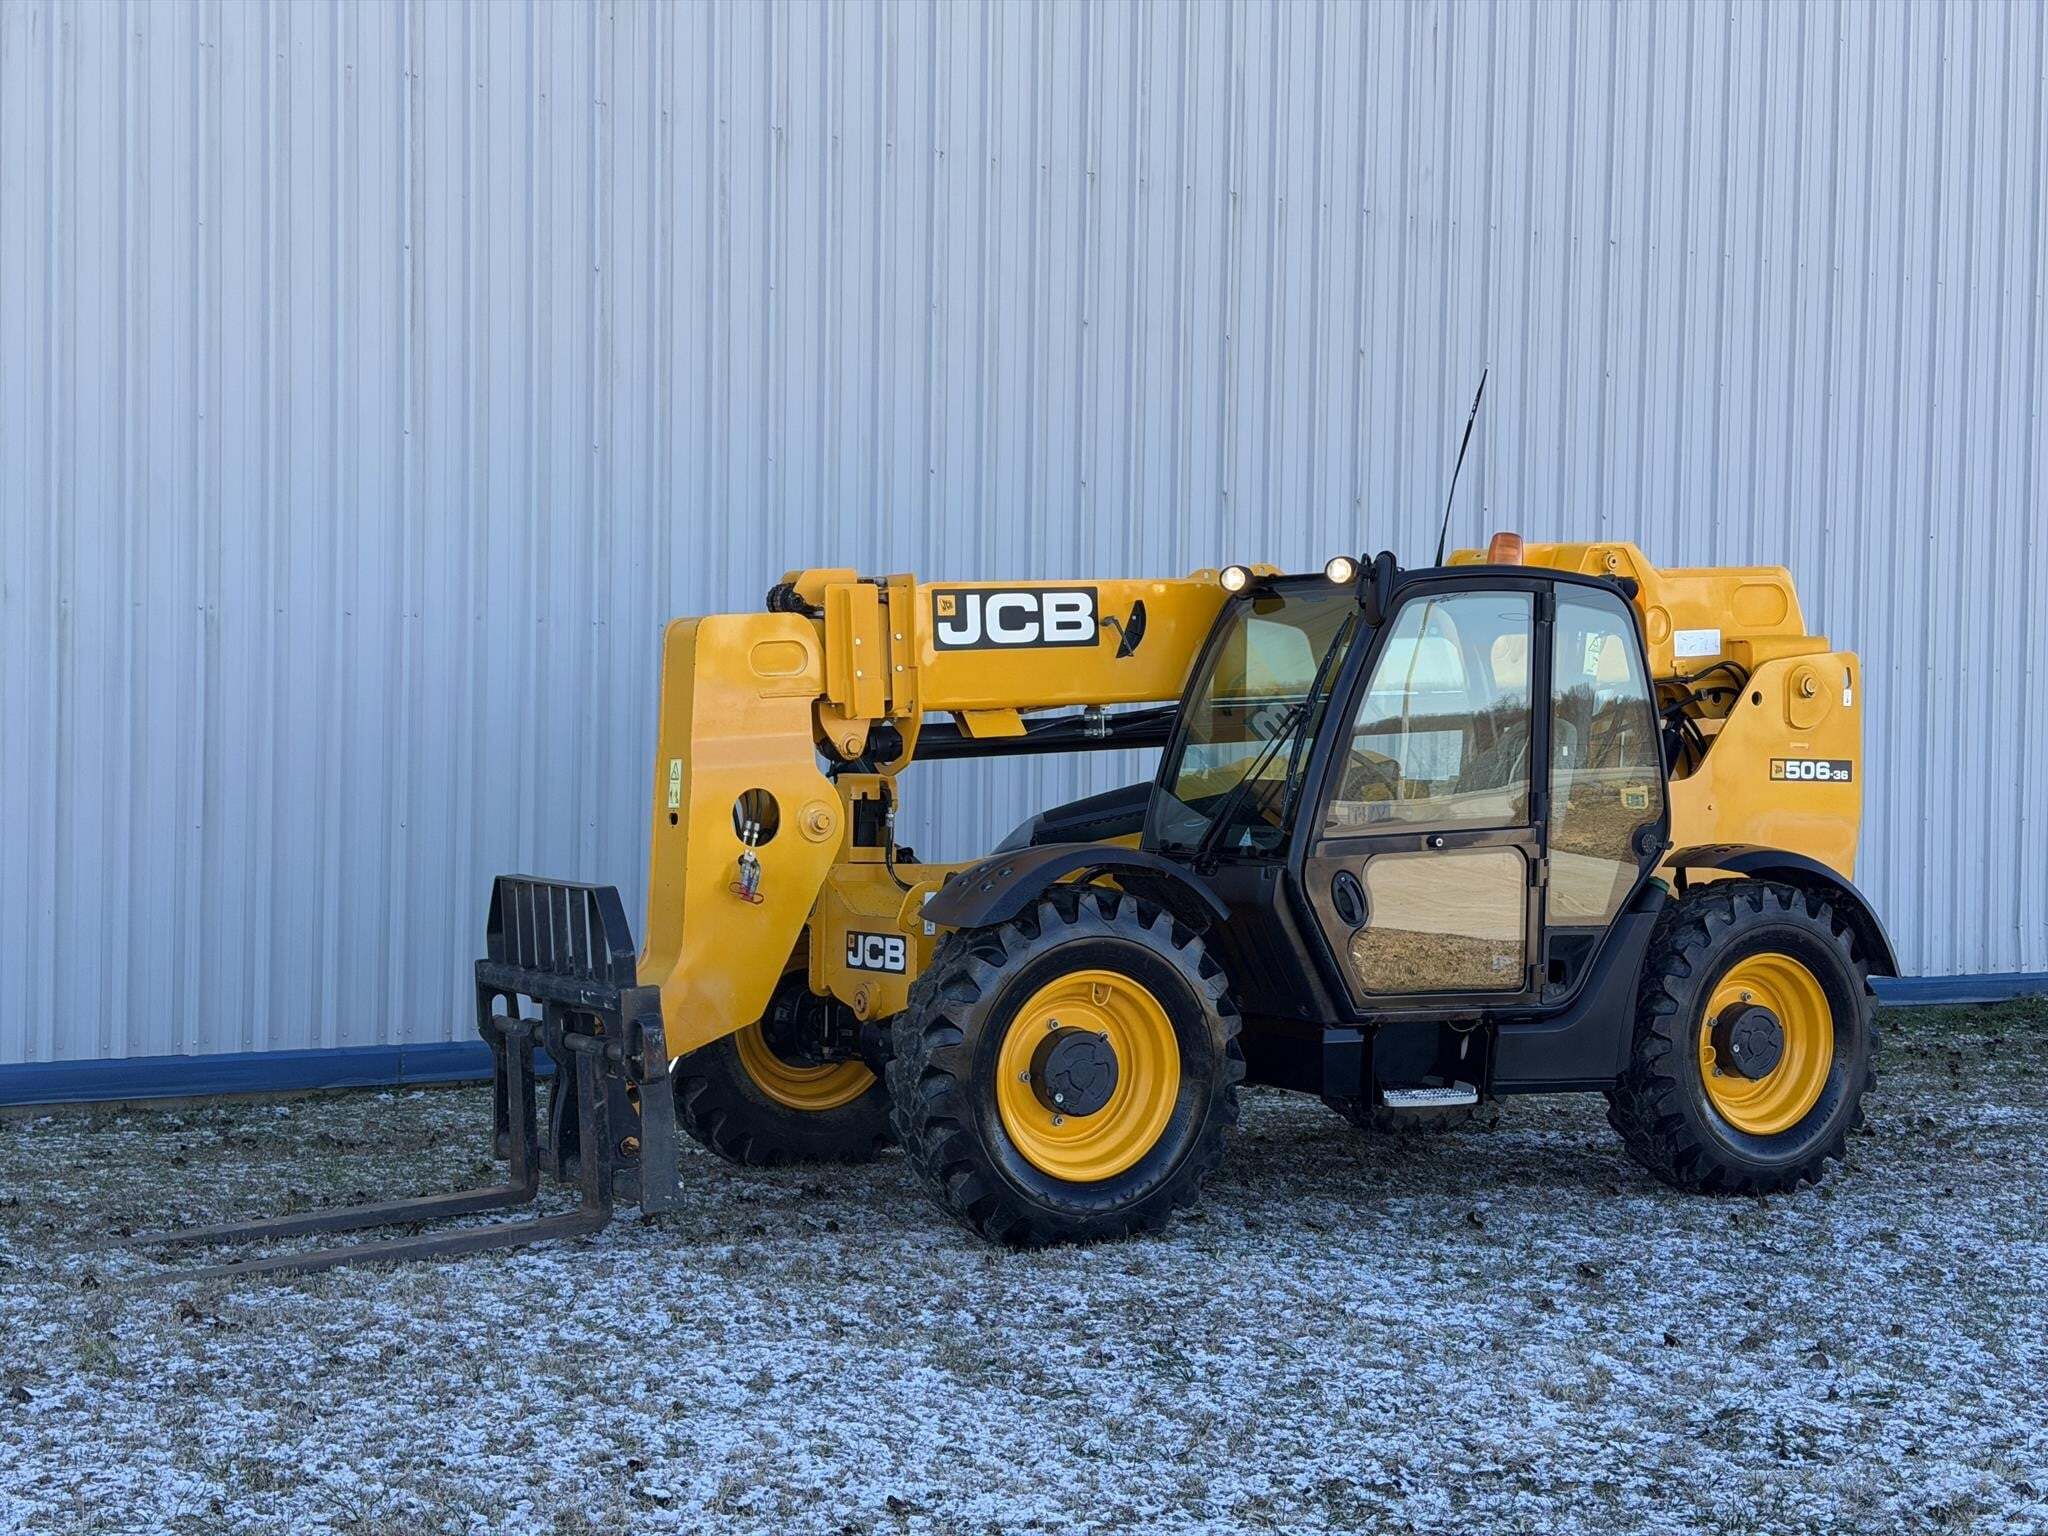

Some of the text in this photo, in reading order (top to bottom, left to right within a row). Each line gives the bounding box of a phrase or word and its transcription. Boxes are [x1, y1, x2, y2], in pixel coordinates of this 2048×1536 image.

[938, 592, 1095, 645] JCB
[1785, 761, 1849, 780] 506-36
[847, 934, 905, 971] JCB
